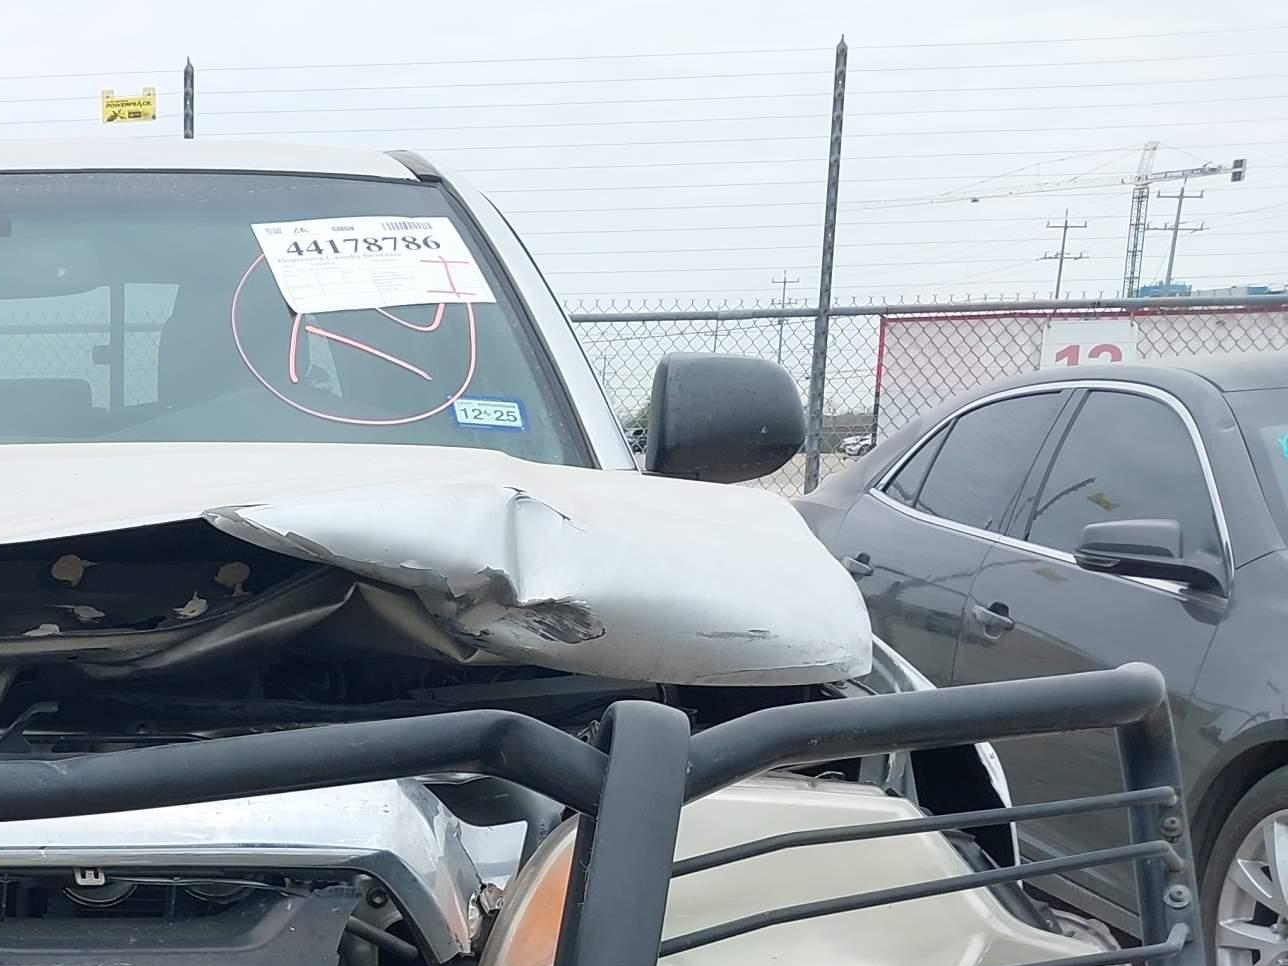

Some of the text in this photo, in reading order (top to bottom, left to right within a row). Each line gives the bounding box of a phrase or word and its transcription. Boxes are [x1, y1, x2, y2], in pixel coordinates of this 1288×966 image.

[286, 234, 441, 256] 44178786
[459, 407, 518, 423] 12 25
